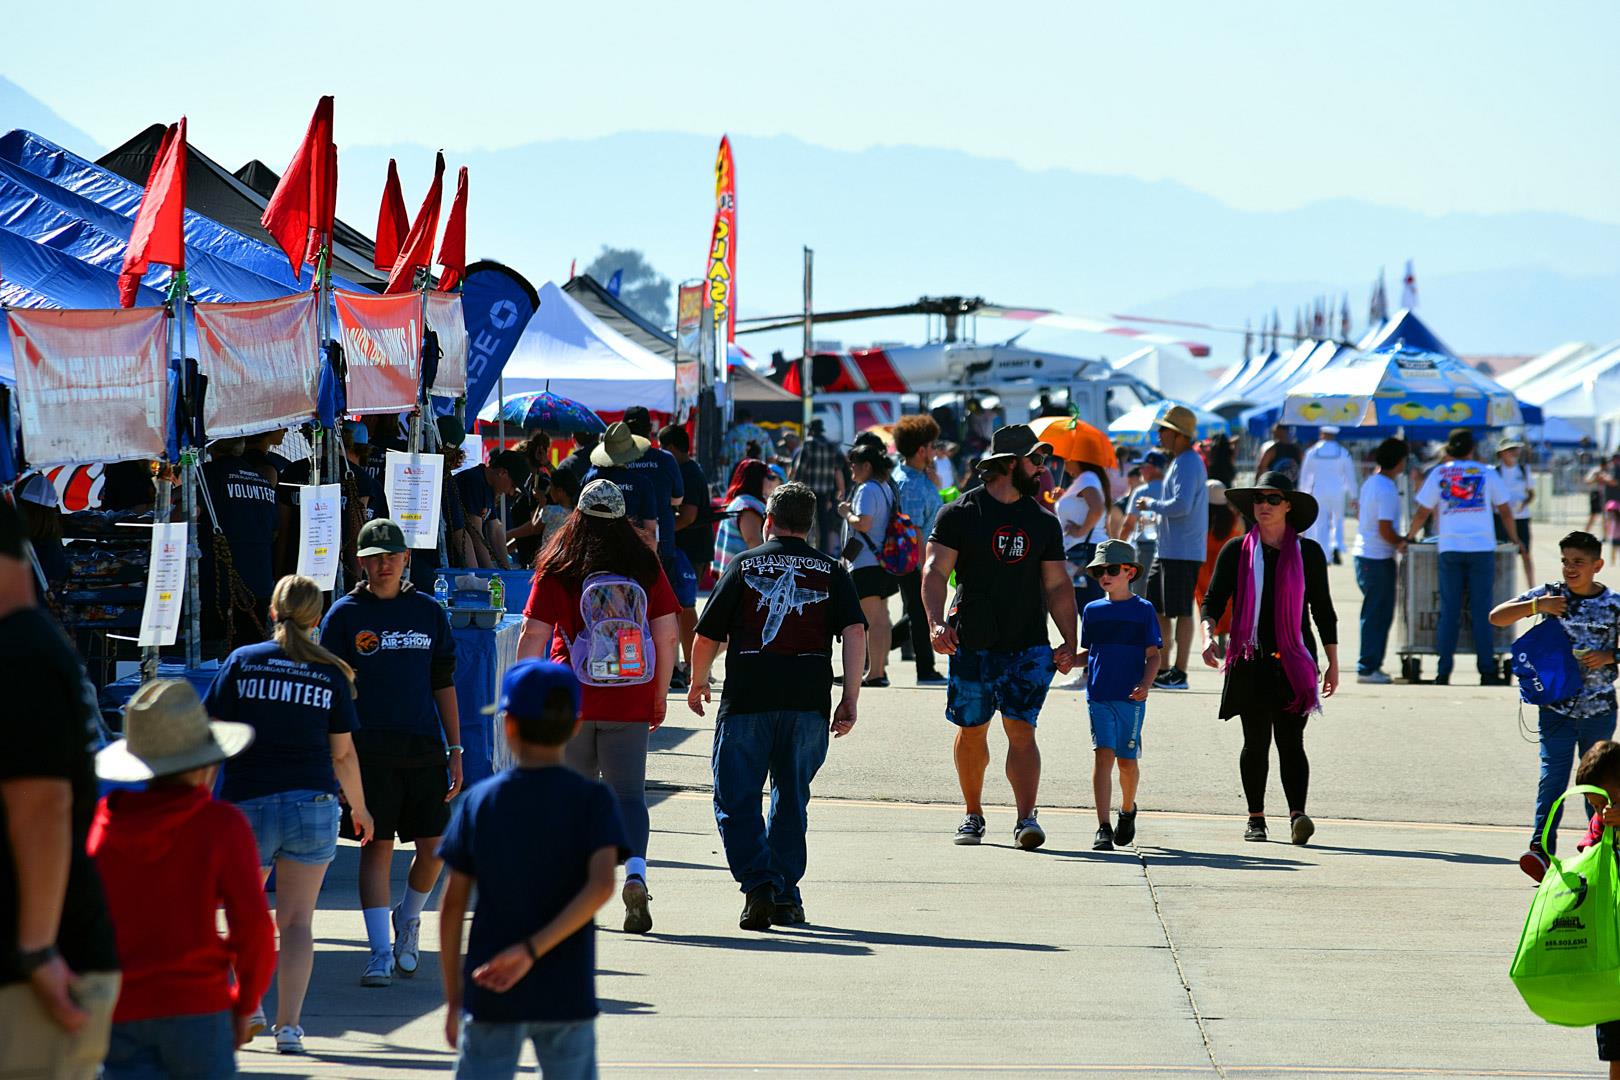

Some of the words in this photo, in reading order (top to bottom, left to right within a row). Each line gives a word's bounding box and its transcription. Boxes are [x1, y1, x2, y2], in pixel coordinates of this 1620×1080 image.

[372, 526, 391, 541] M
[741, 554, 832, 574] PHANTOM
[758, 566, 774, 575] F-4
[236, 678, 333, 711] VOLUNTEER
